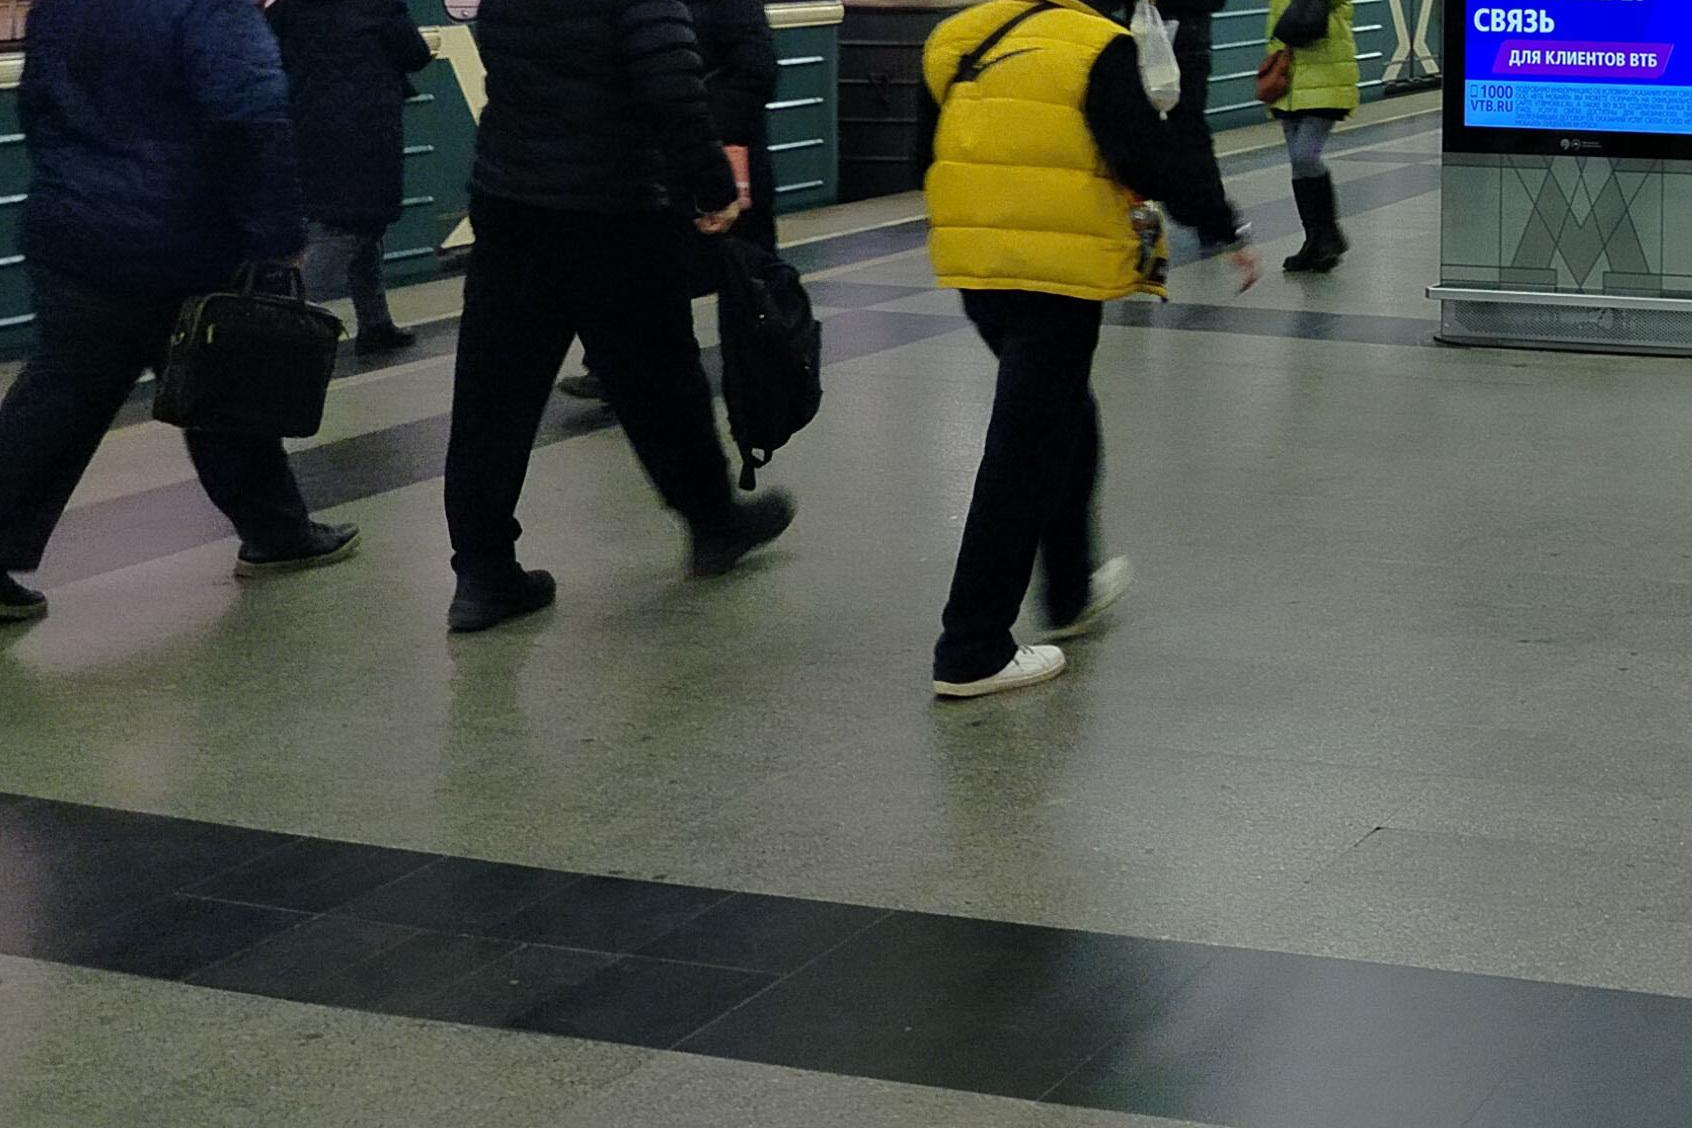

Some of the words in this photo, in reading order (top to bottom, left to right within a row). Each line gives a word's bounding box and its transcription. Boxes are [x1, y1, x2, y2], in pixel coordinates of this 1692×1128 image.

[1473, 7, 1556, 34] СВЯЗЬ
[1508, 49, 1541, 67] ДЛЯ
[1545, 50, 1626, 67] КЛИЕНТОВ
[1629, 52, 1658, 68] ВТБ
[1480, 84, 1514, 99] 1000
[1470, 99, 1514, 113] VTB.RU
